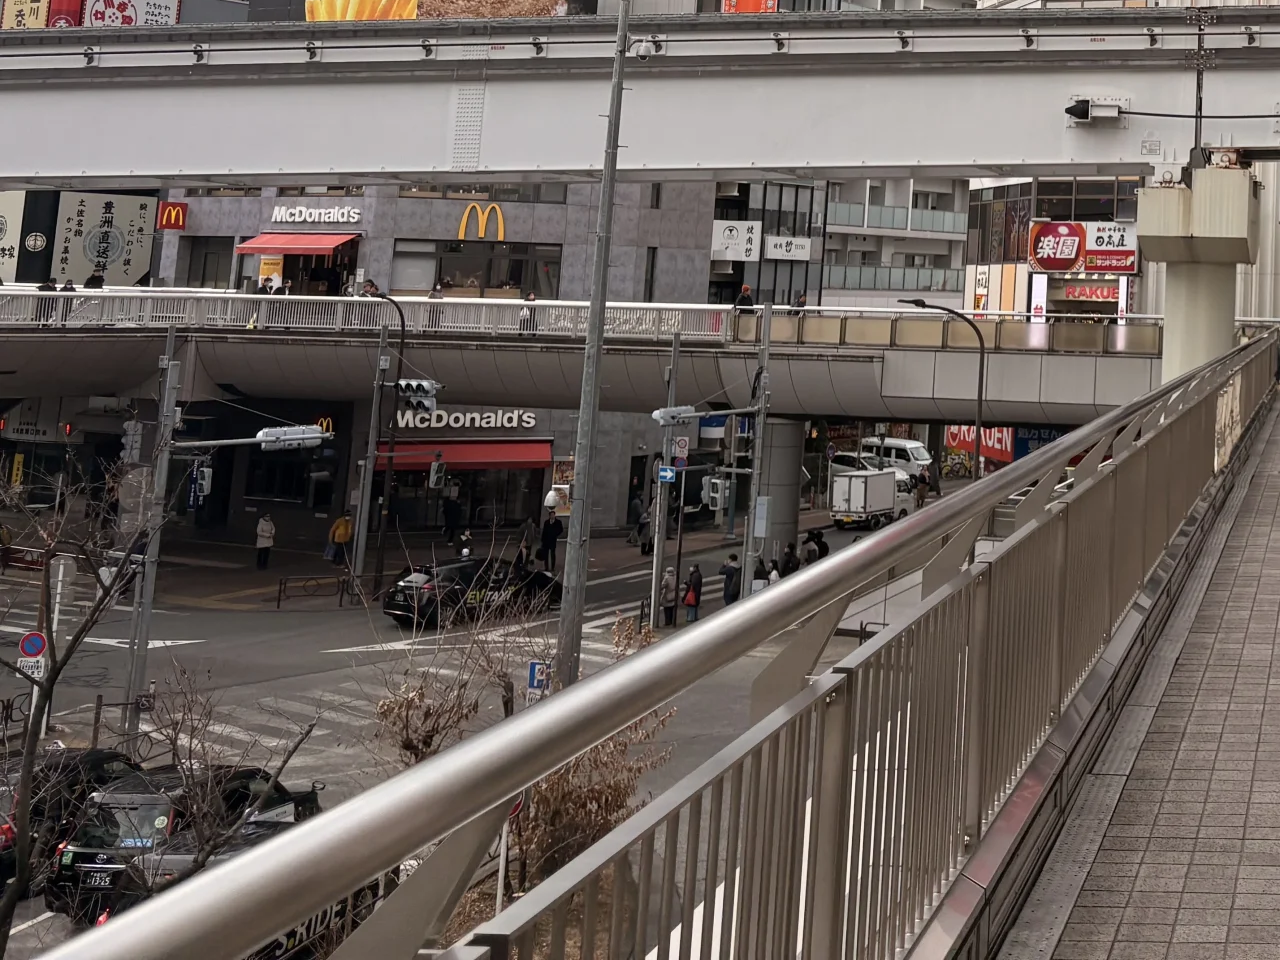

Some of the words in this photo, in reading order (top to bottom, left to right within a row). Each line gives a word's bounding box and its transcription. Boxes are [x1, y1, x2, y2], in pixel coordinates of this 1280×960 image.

[271, 206, 361, 223] McDonald's
[1036, 235, 1080, 259] 楽園
[1095, 234, 1127, 248] 日高屋
[1065, 285, 1119, 300] RAKUE
[397, 409, 536, 429] McDonald's
